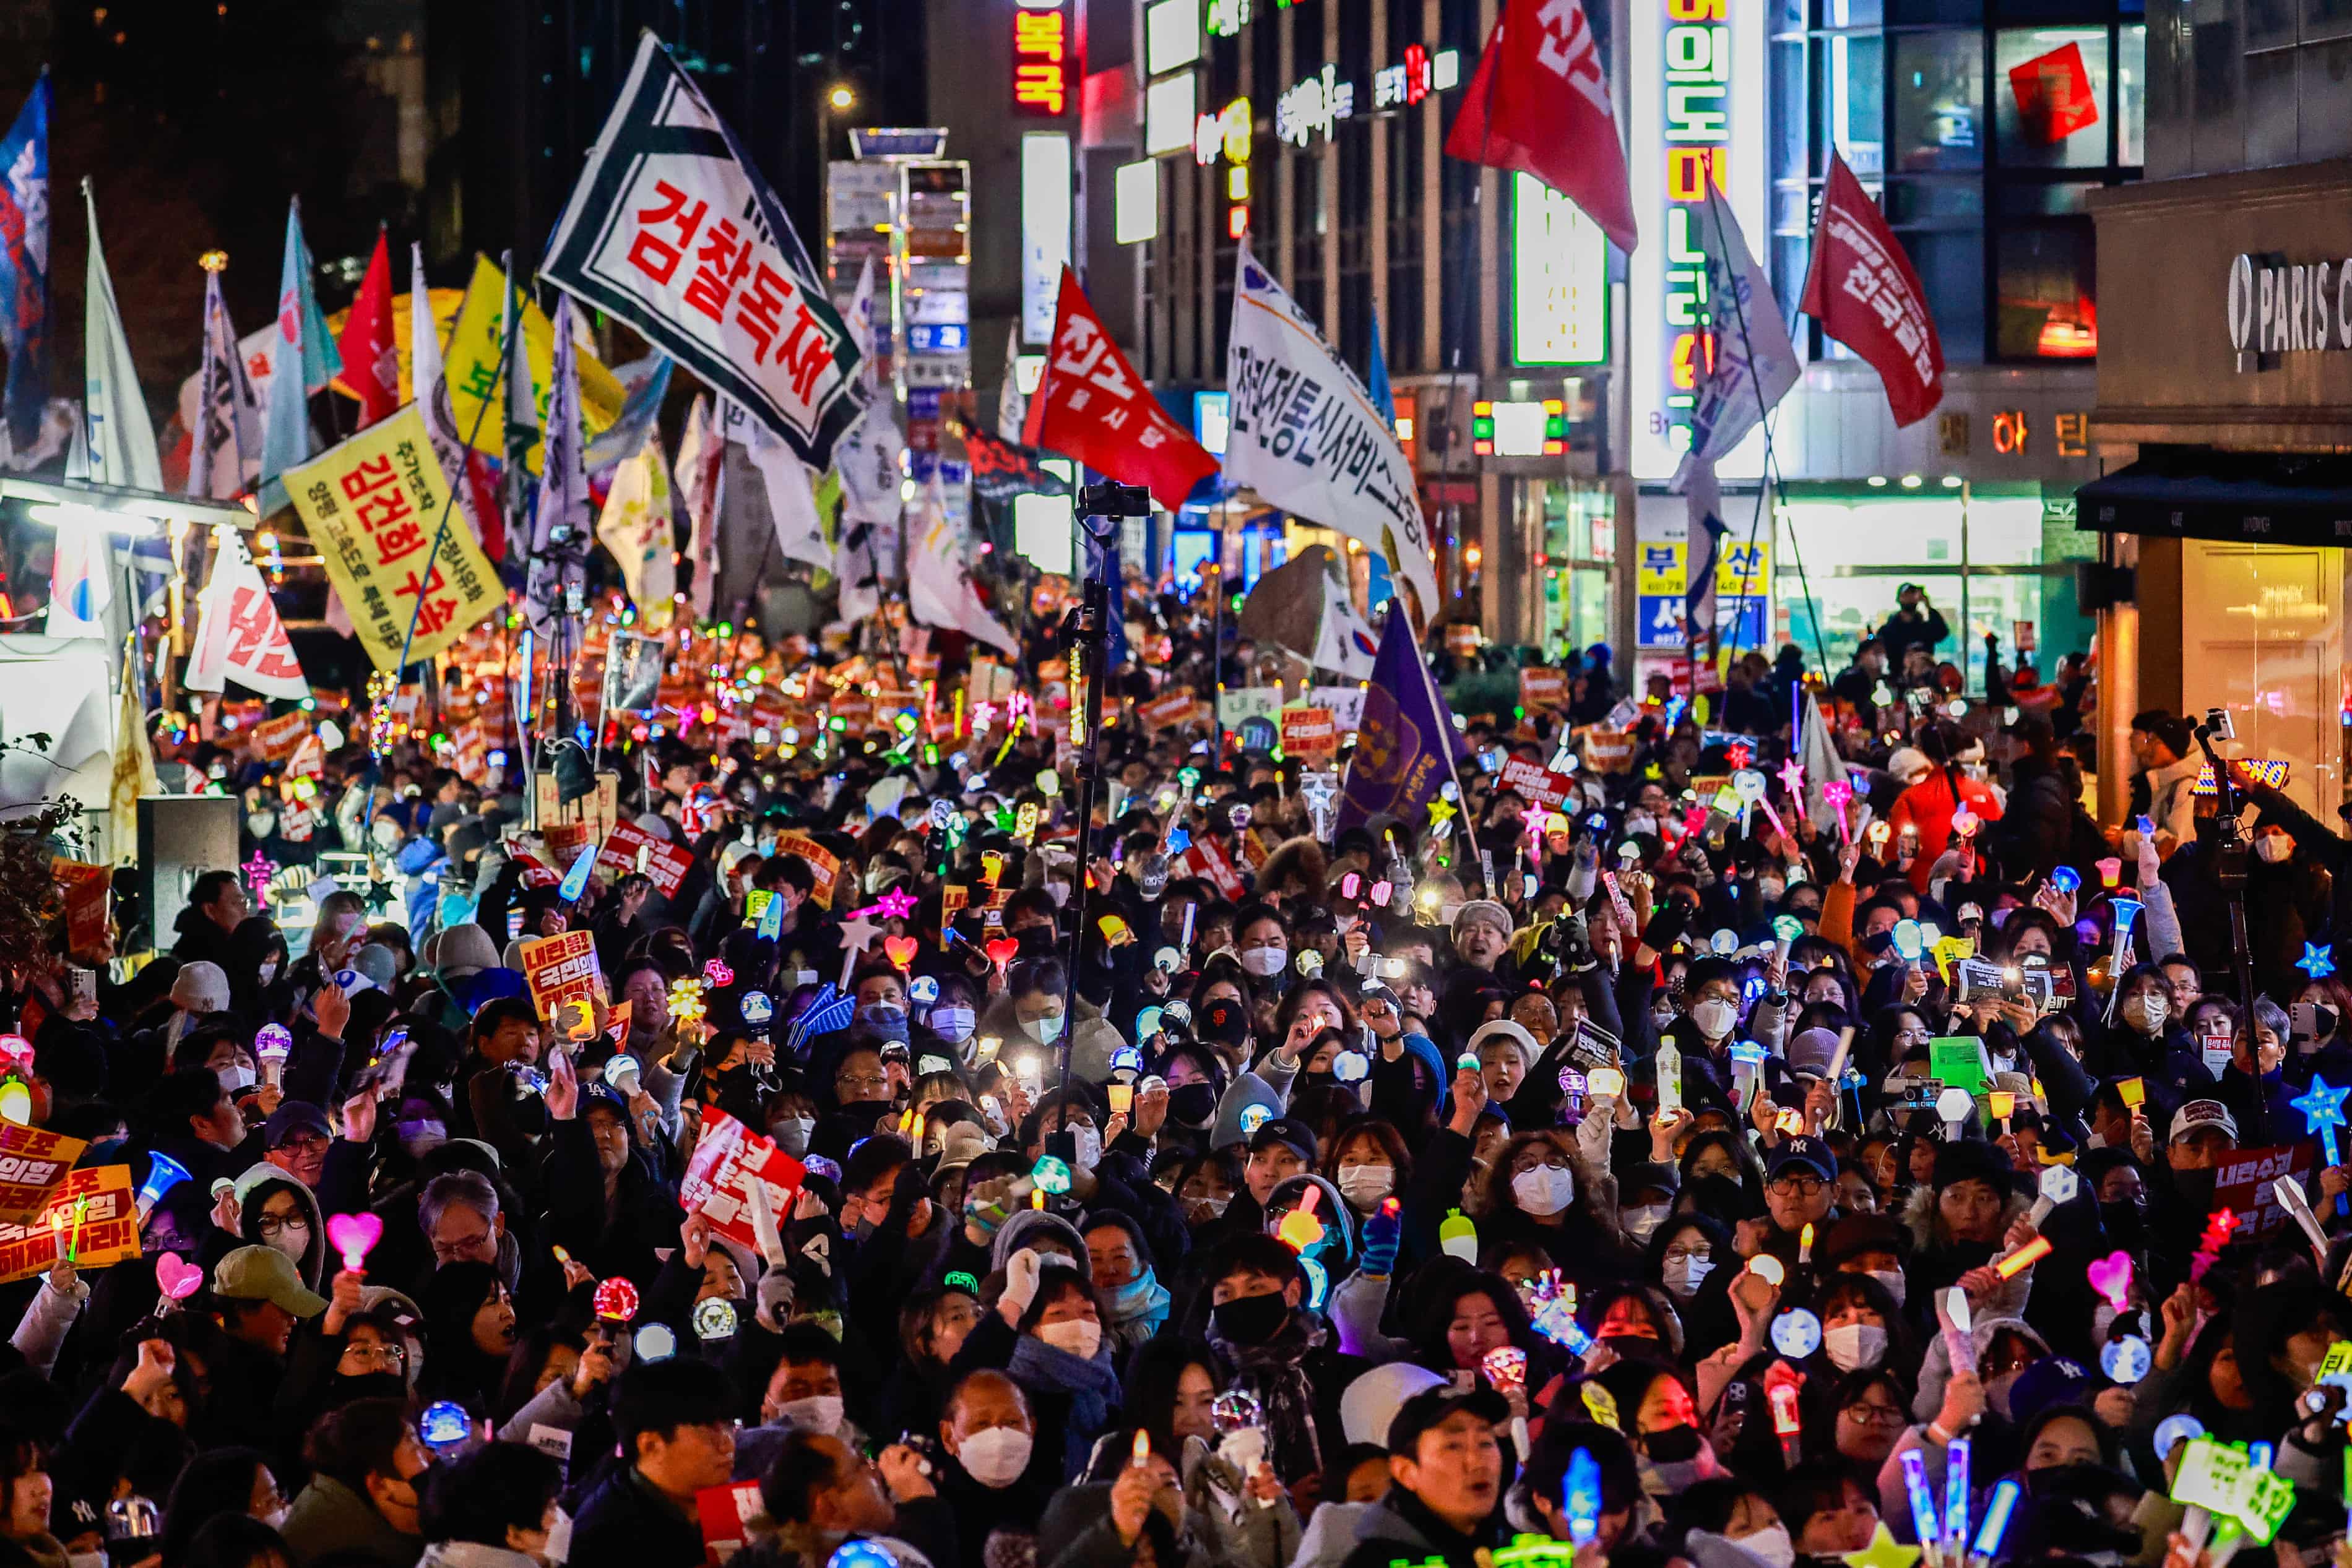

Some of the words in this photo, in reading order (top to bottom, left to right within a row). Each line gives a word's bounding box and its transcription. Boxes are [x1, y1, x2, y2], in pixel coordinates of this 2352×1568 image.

[627, 178, 836, 407] 검찰독재
[2259, 262, 2329, 352] PARIS
[395, 439, 436, 512] 주가조작
[340, 453, 427, 566] 김건희
[394, 567, 459, 637] 구속
[1643, 546, 1763, 575] 부산
[0, 1123, 62, 1157] 동조
[1789, 1137, 1808, 1153] NY
[0, 1156, 59, 1184] 의힘
[2054, 1359, 2085, 1380] LA
